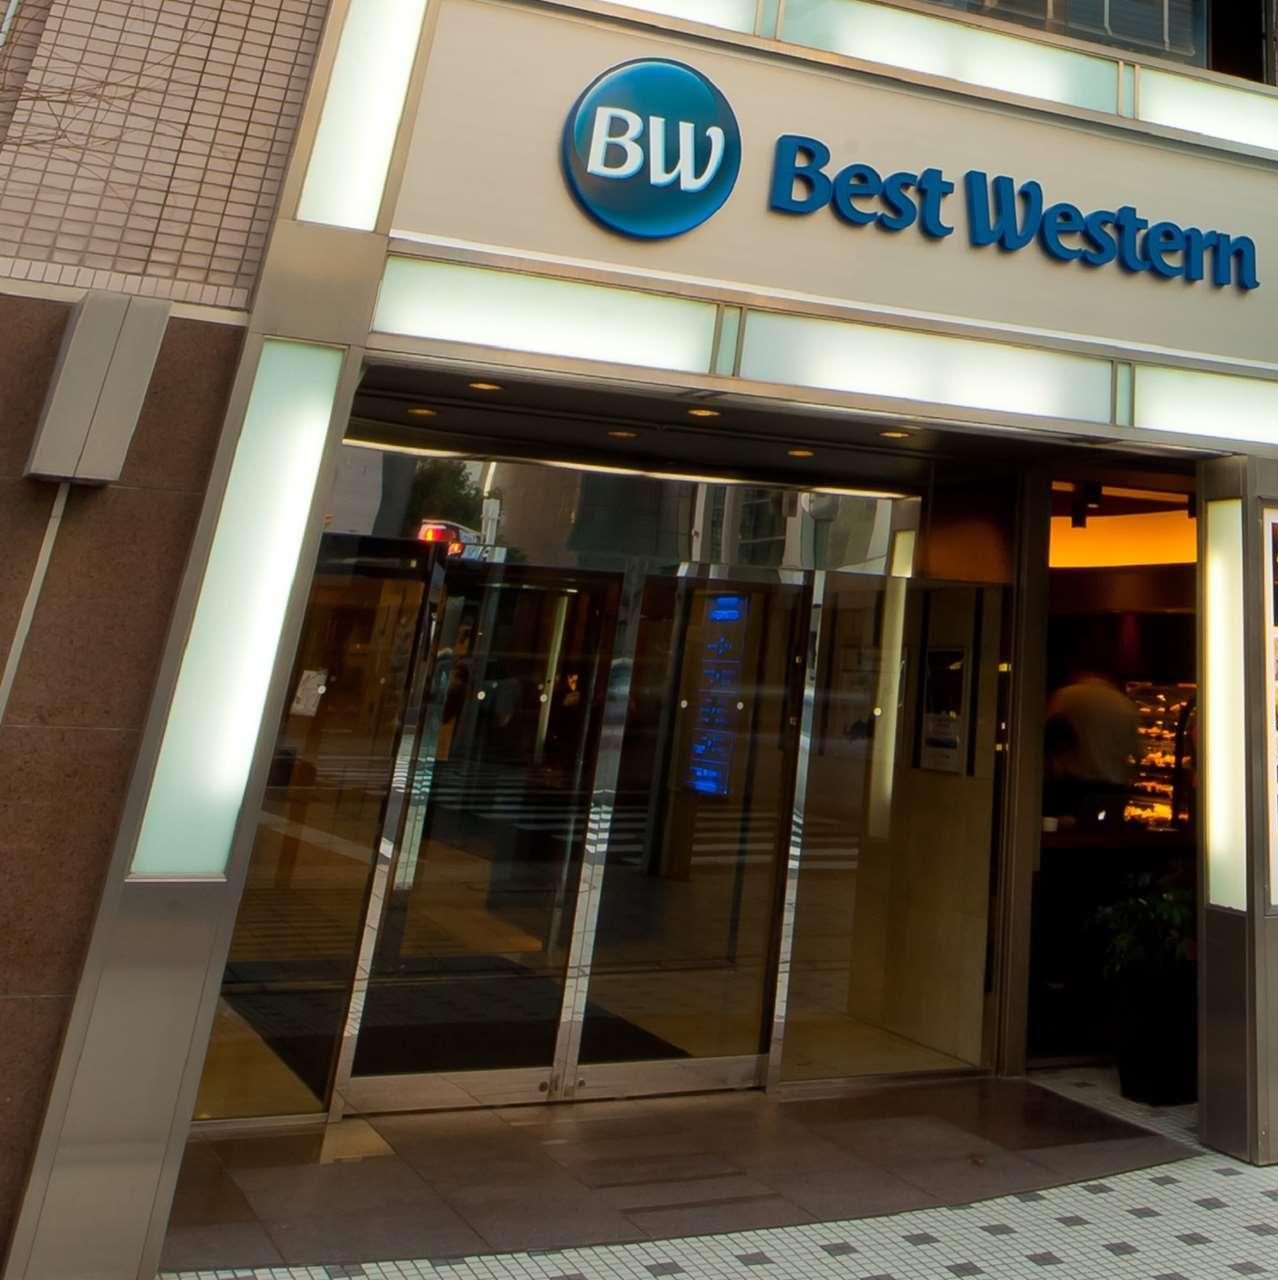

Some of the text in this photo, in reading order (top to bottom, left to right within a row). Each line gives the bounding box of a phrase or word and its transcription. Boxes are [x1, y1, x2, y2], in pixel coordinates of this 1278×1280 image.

[587, 107, 724, 192] BW
[771, 134, 1260, 291] Best Western
